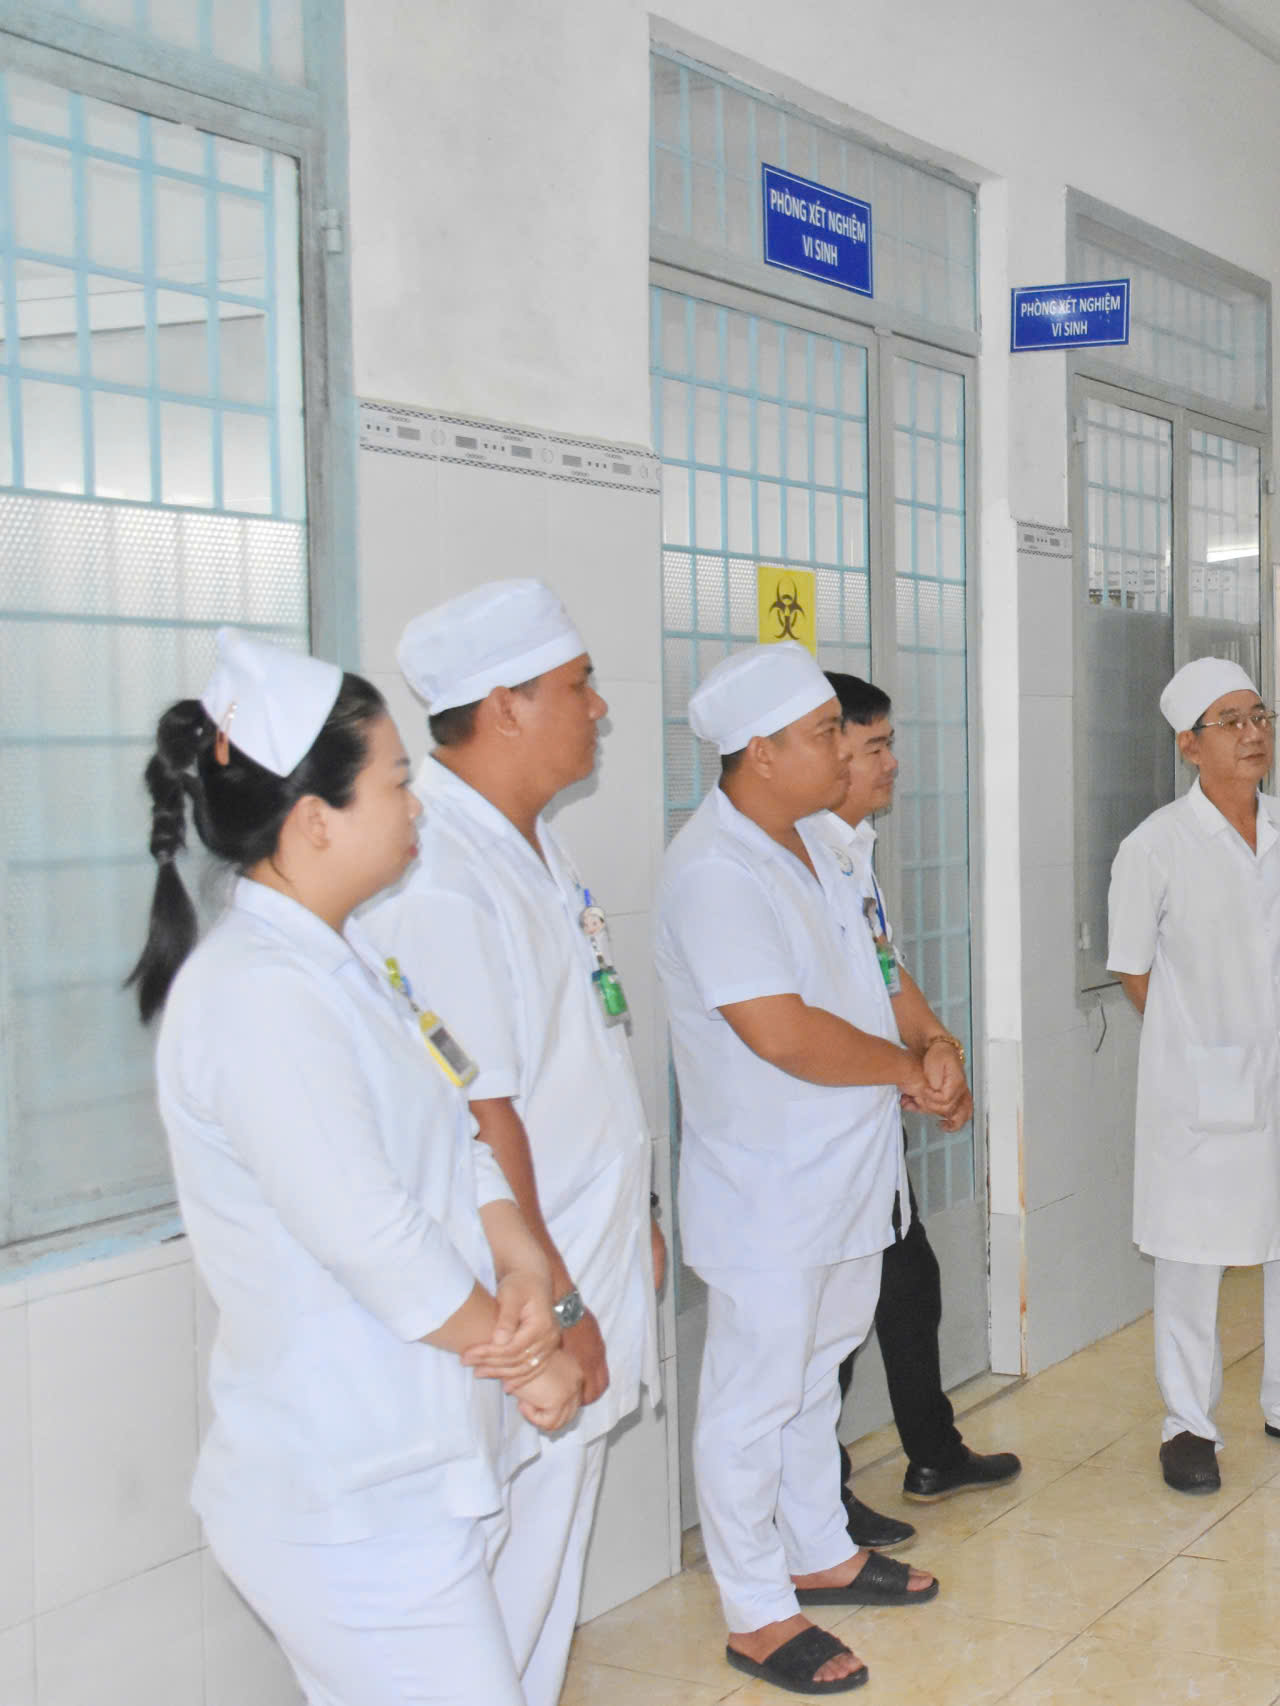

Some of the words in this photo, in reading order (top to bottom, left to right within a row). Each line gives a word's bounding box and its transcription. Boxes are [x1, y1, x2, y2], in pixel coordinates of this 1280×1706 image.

[770, 188, 807, 222] PHÒNG
[809, 200, 826, 229] XÉT
[828, 210, 866, 245] NGHIỆM
[802, 234, 813, 258] VI
[815, 239, 838, 267] SINH
[1021, 298, 1057, 318] PHÒNG
[1058, 295, 1077, 314] XÉT
[1079, 292, 1120, 314] NGHIỆM
[1051, 323, 1062, 337] VI
[1064, 320, 1088, 336] SINH
